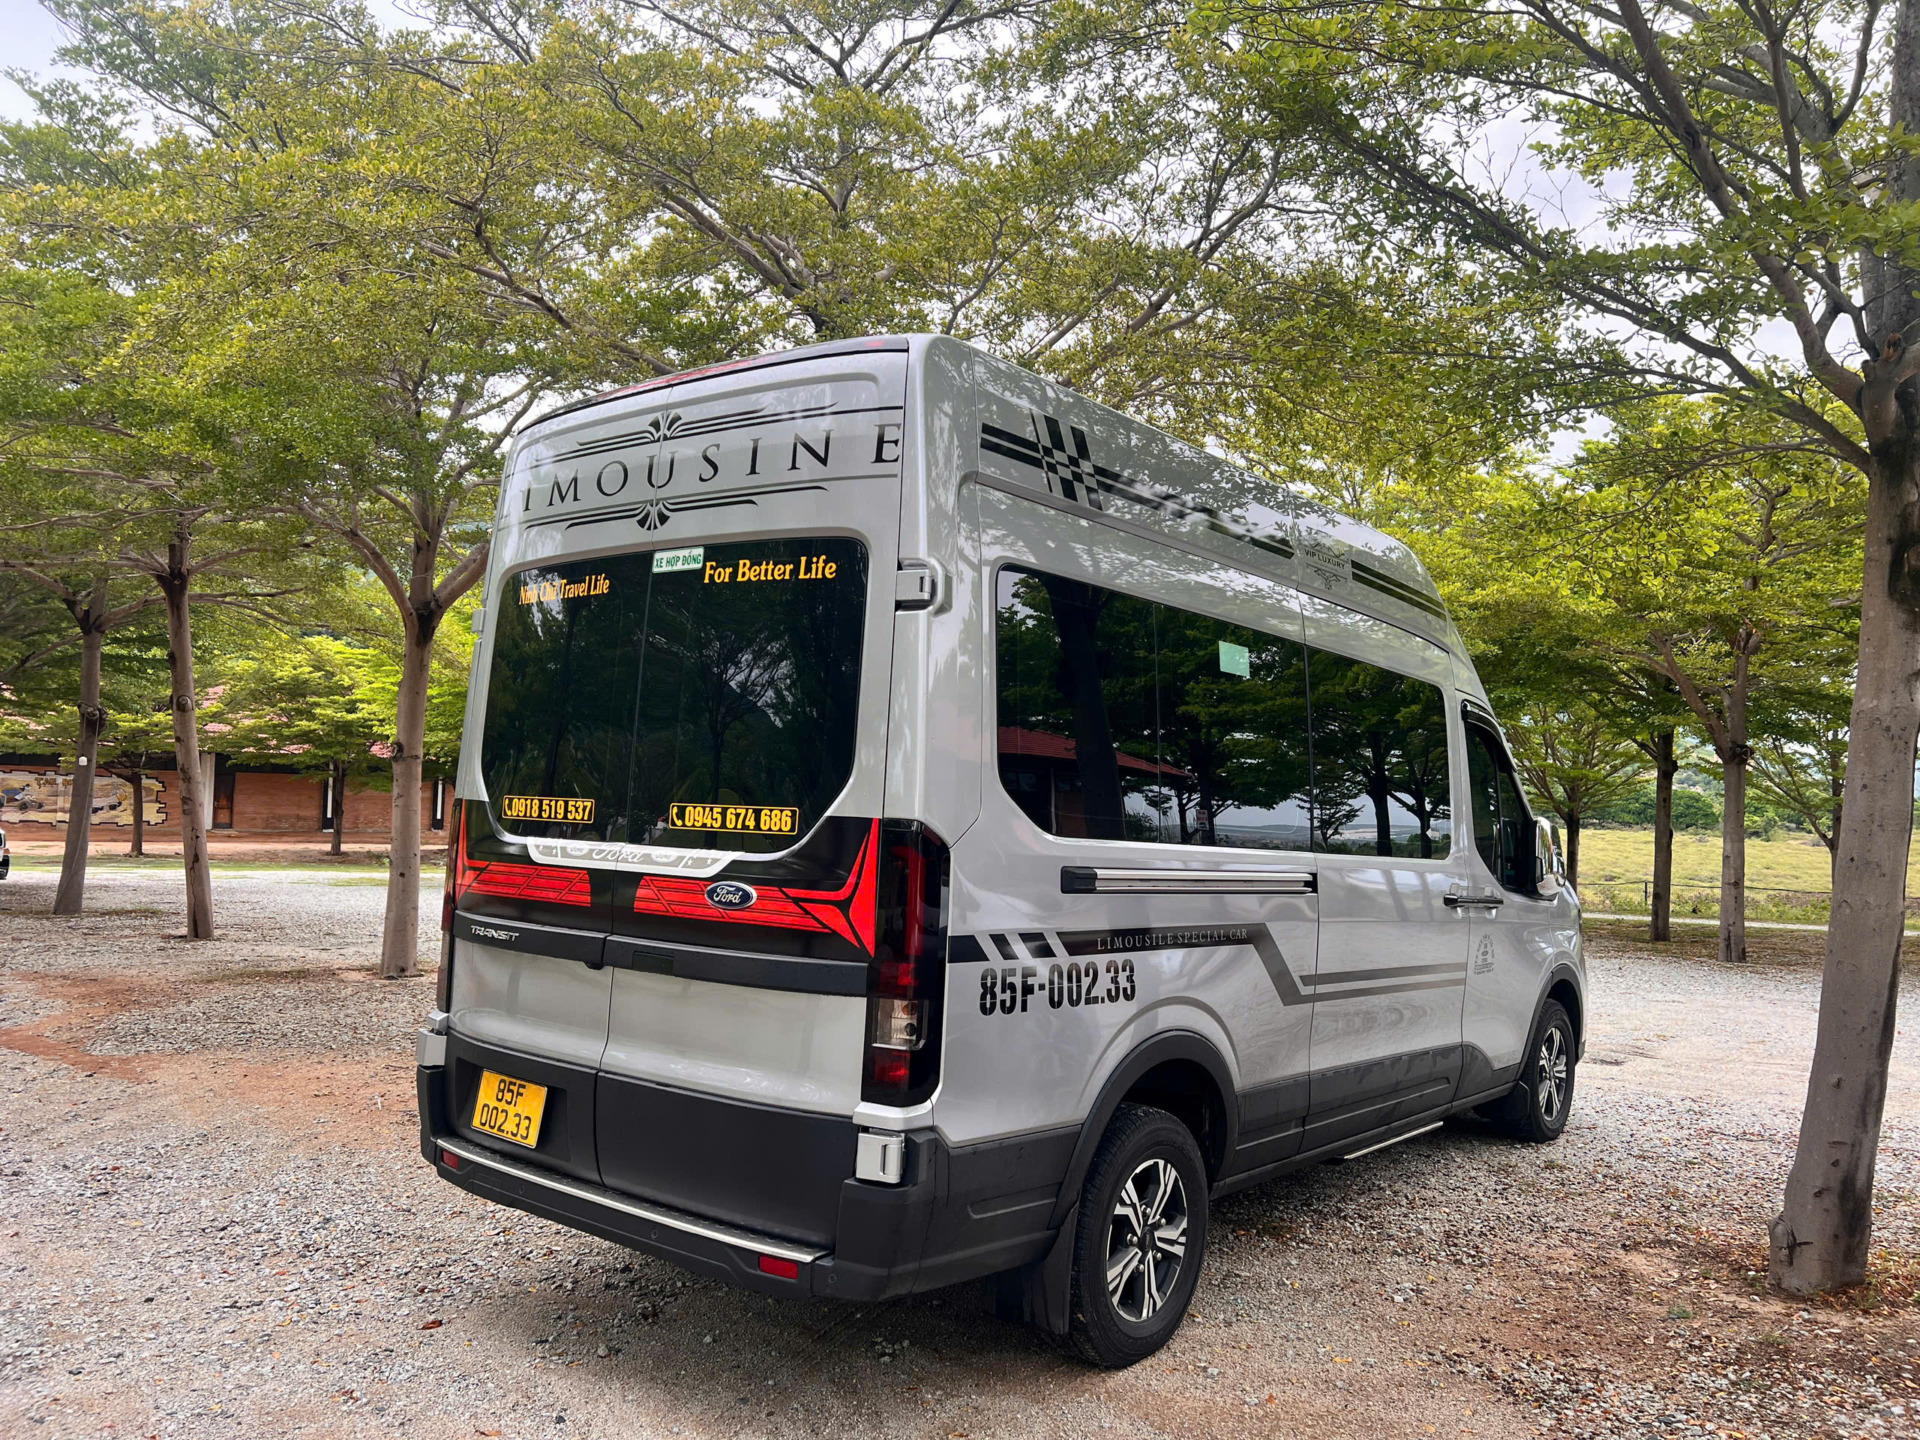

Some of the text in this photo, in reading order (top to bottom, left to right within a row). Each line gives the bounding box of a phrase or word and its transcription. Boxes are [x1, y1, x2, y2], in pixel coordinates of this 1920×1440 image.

[654, 557, 664, 568] XE
[703, 554, 837, 584] For Better Life
[1304, 549, 1316, 558] VIP
[1317, 554, 1346, 569] LUXURY
[560, 576, 590, 601] Travel
[590, 573, 610, 596] Life
[511, 798, 592, 820] 0918 519 537
[684, 806, 792, 832] 0945 674 686
[592, 843, 645, 863] Ford
[713, 885, 743, 904] Ford
[470, 924, 520, 942] TRANSIT
[1097, 927, 1248, 950] LIMOUSILE SPECIAL CAR
[979, 958, 1136, 1016] 85F-002.33
[495, 1078, 527, 1107] 85F
[479, 1103, 532, 1140] 002.33
